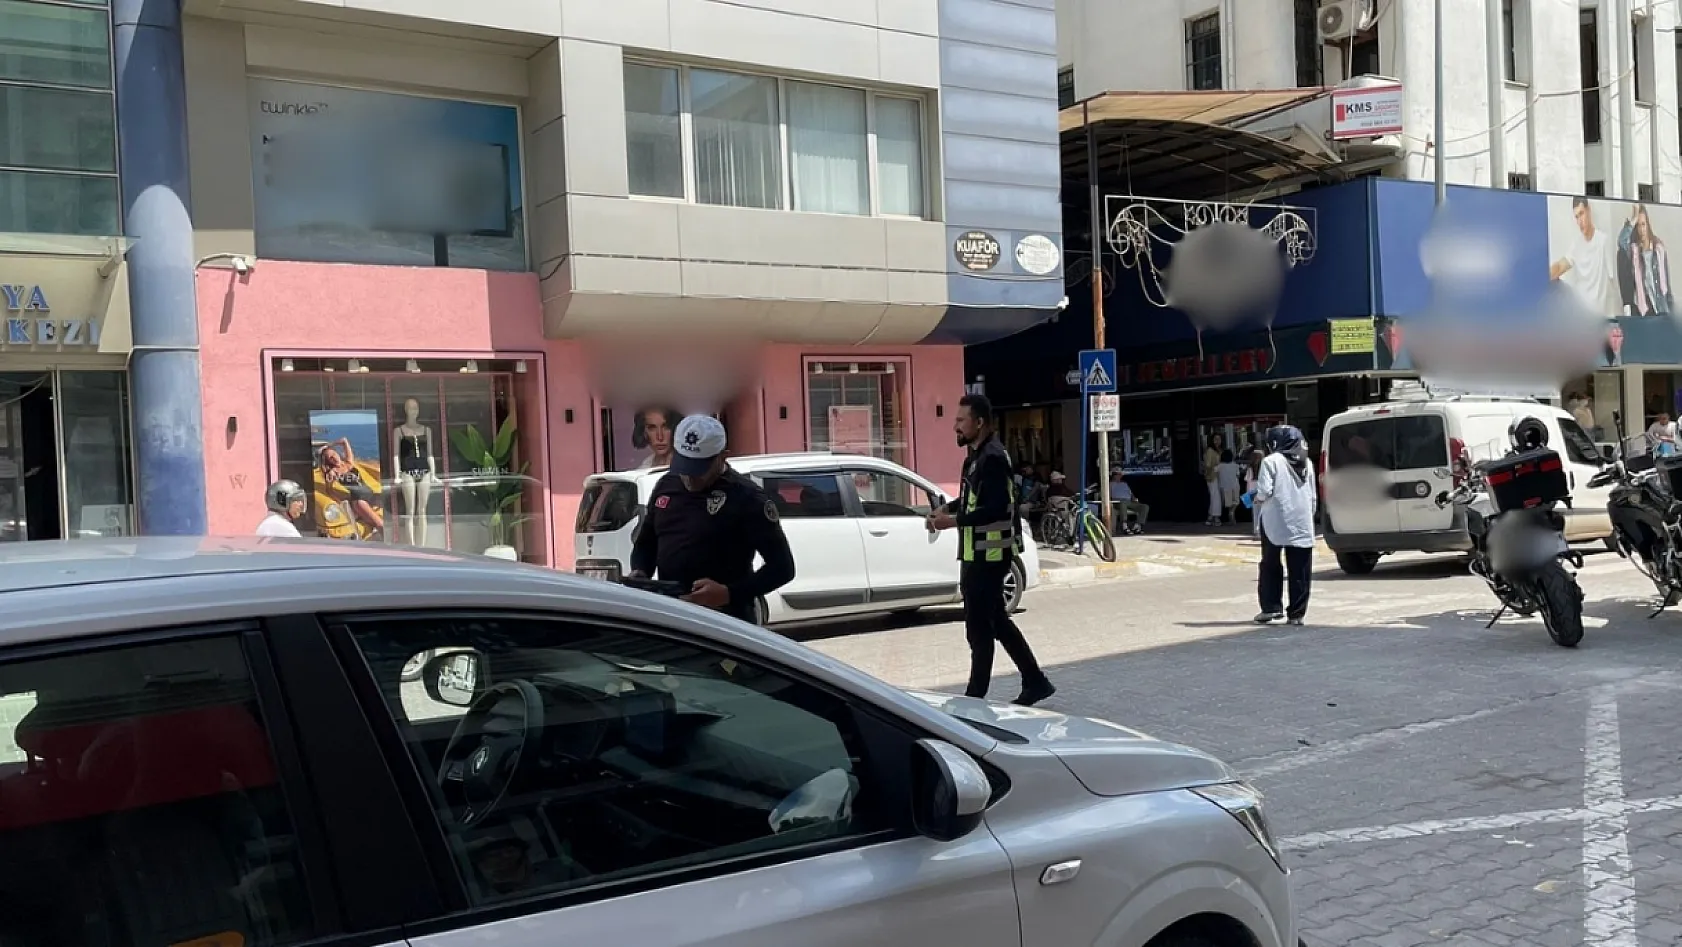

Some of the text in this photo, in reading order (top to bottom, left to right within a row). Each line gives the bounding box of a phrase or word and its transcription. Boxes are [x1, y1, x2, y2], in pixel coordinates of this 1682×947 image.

[1345, 101, 1372, 114] KMS
[956, 239, 999, 255] KUAFÖR
[0, 284, 50, 311] YA
